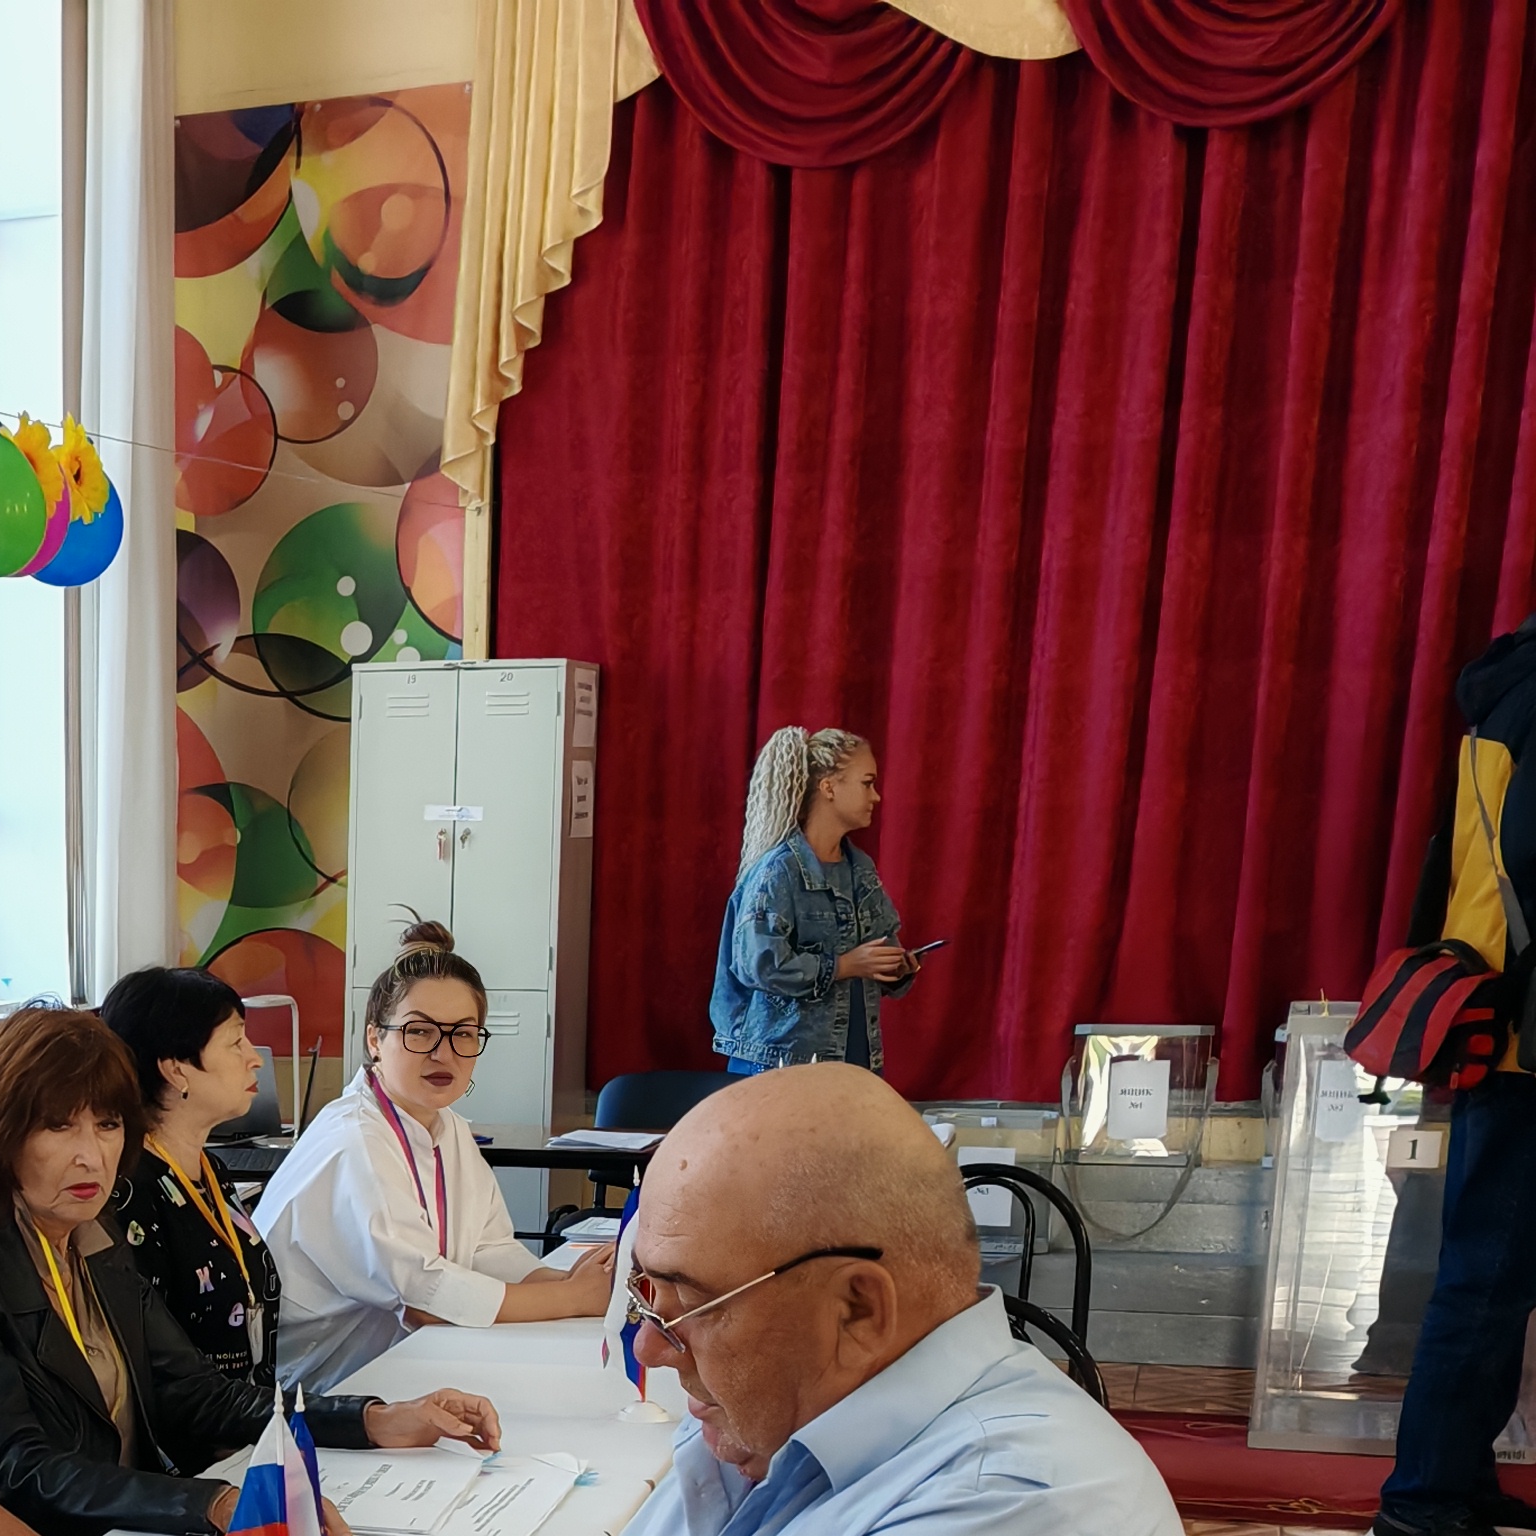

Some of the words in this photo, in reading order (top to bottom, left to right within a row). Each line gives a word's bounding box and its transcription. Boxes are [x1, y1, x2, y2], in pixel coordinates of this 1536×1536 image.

[407, 674, 416, 684] 19
[500, 672, 513, 683] 20
[1407, 1138, 1420, 1161] 1
